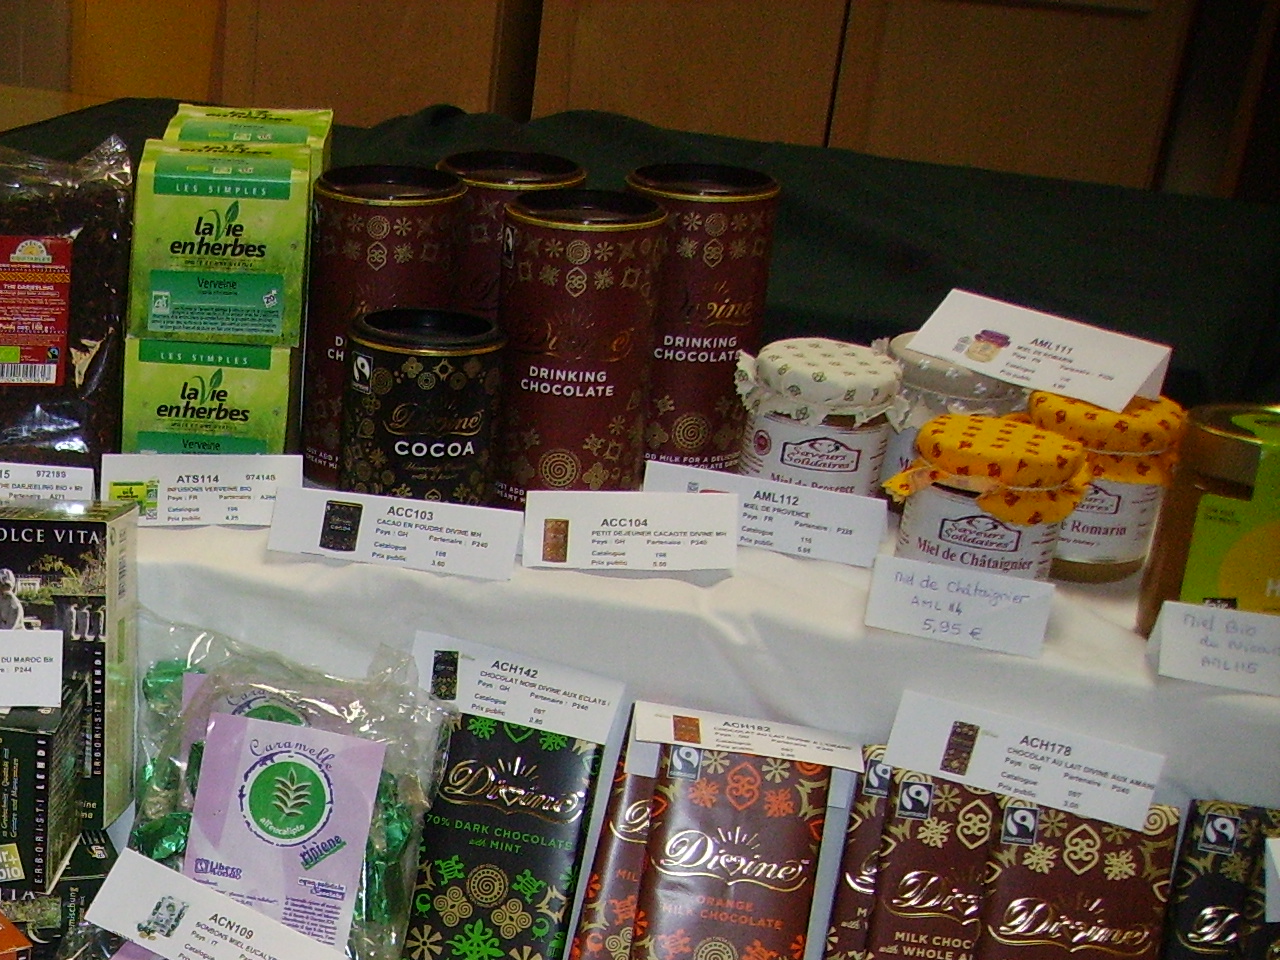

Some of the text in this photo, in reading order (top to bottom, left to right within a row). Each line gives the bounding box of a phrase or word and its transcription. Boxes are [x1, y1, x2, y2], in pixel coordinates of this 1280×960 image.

[176, 183, 267, 196] LES SIMPLES
[197, 277, 237, 289] Verveine
[664, 335, 737, 348] DRINKING
[1031, 338, 1073, 354] AML111
[192, 353, 248, 365] SIMPLES
[529, 366, 607, 383] DRINKING
[521, 378, 614, 397] CHOCOLATE
[394, 440, 475, 457] COCOA
[177, 475, 220, 483] ATS114
[754, 490, 799, 505] AML112
[387, 506, 434, 521] ACC103
[601, 518, 648, 528] ACC104
[54, 530, 100, 544] VITA
[917, 538, 1033, 571] Miel de Châtaignier
[920, 575, 939, 590] de
[491, 660, 539, 678] ACH142
[1020, 735, 1072, 757] ACH178
[426, 813, 573, 850] 70% DARK CHOCOLATE
[300, 835, 344, 865] ripiene
[490, 839, 521, 853] MINT
[660, 829, 810, 881] Divine
[697, 896, 753, 911] ORANGE
[662, 903, 784, 930] MILK CHOCOLATE
[209, 913, 255, 940] ACN109
[894, 931, 927, 946] MILK
